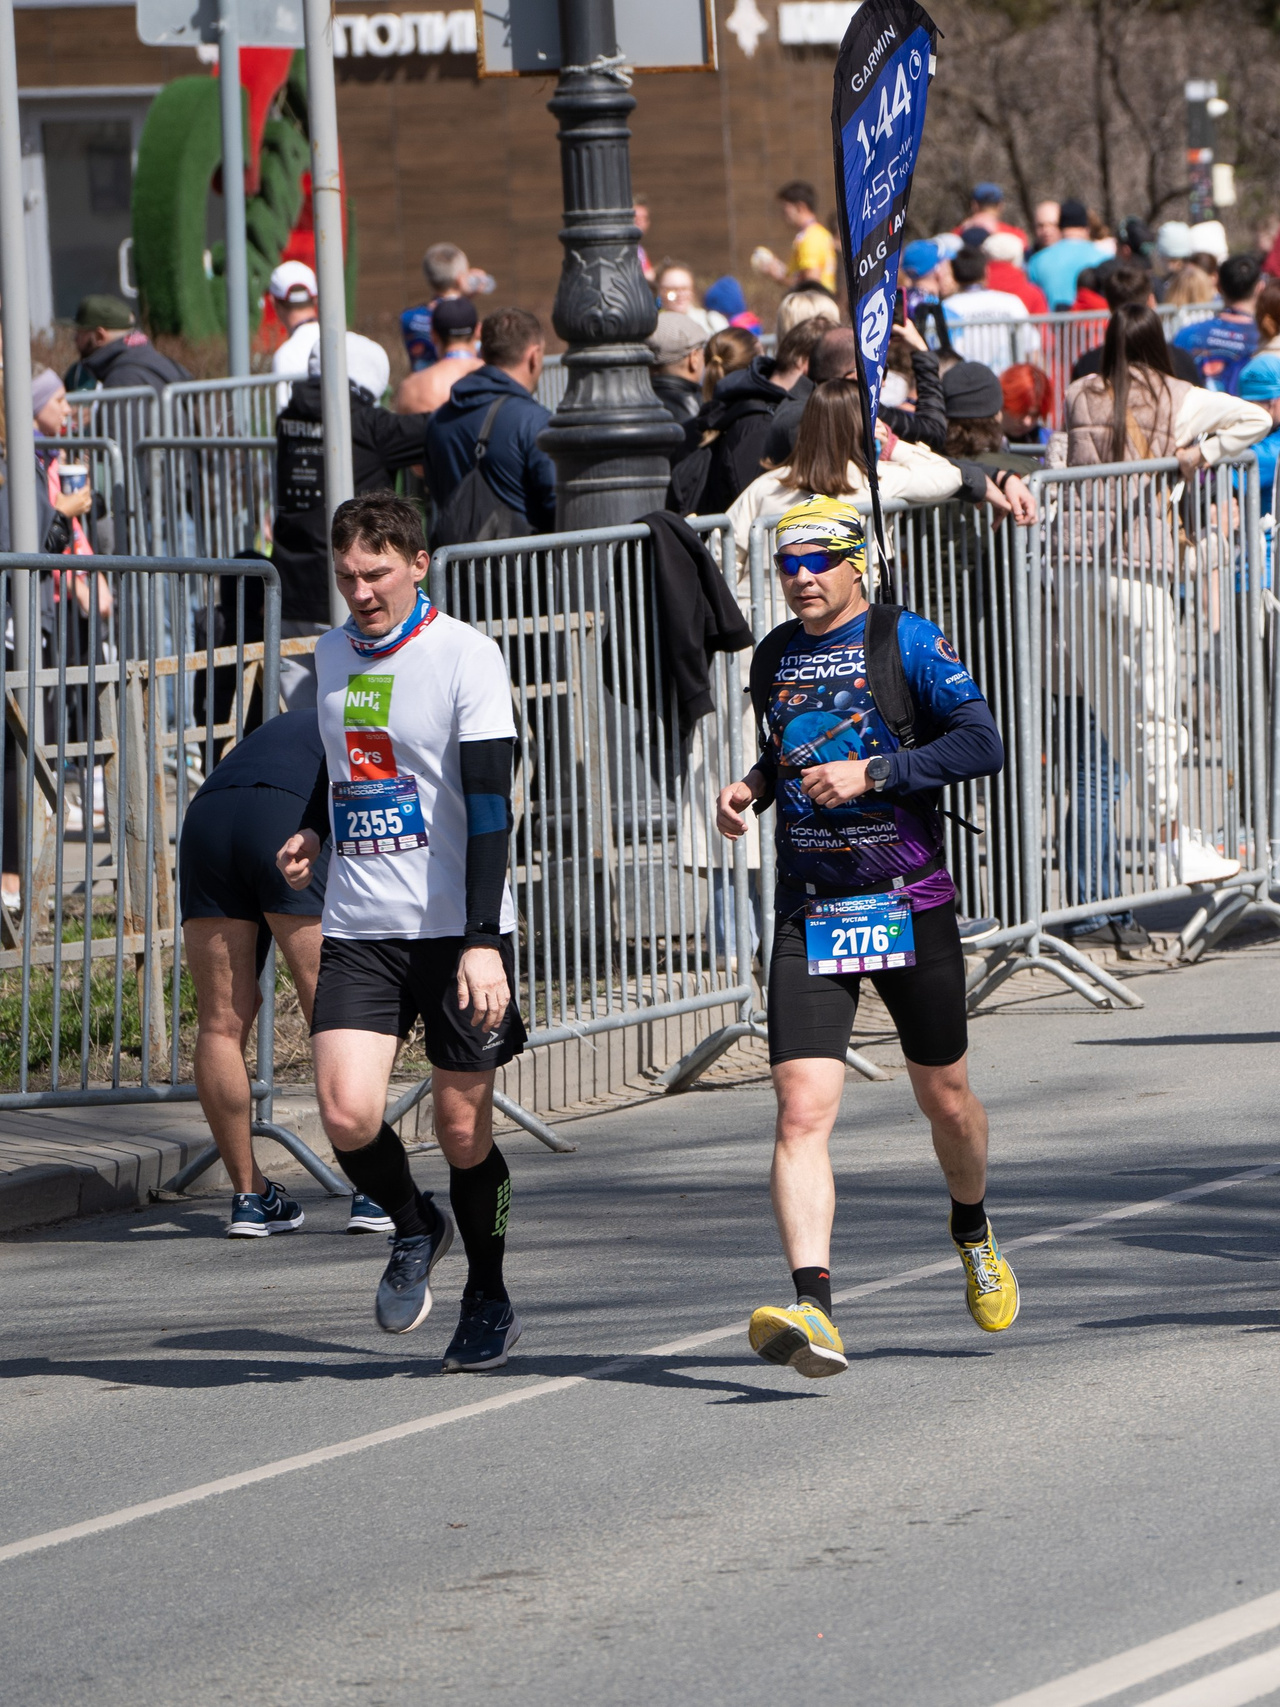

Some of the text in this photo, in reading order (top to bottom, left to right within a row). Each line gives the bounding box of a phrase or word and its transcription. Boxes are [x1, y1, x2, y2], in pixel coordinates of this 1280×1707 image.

[333, 10, 477, 57] ПОЛИ
[851, 24, 897, 92] GARMIN
[857, 63, 912, 175] 1:44
[777, 523, 828, 534] SCHER
[349, 748, 382, 765] Crs
[402, 804, 413, 814] D
[347, 807, 403, 838] 2355
[836, 904, 877, 913] КОСМОС
[841, 916, 868, 924] РУСТАМ
[889, 926, 899, 935] C
[831, 925, 889, 956] 2176
